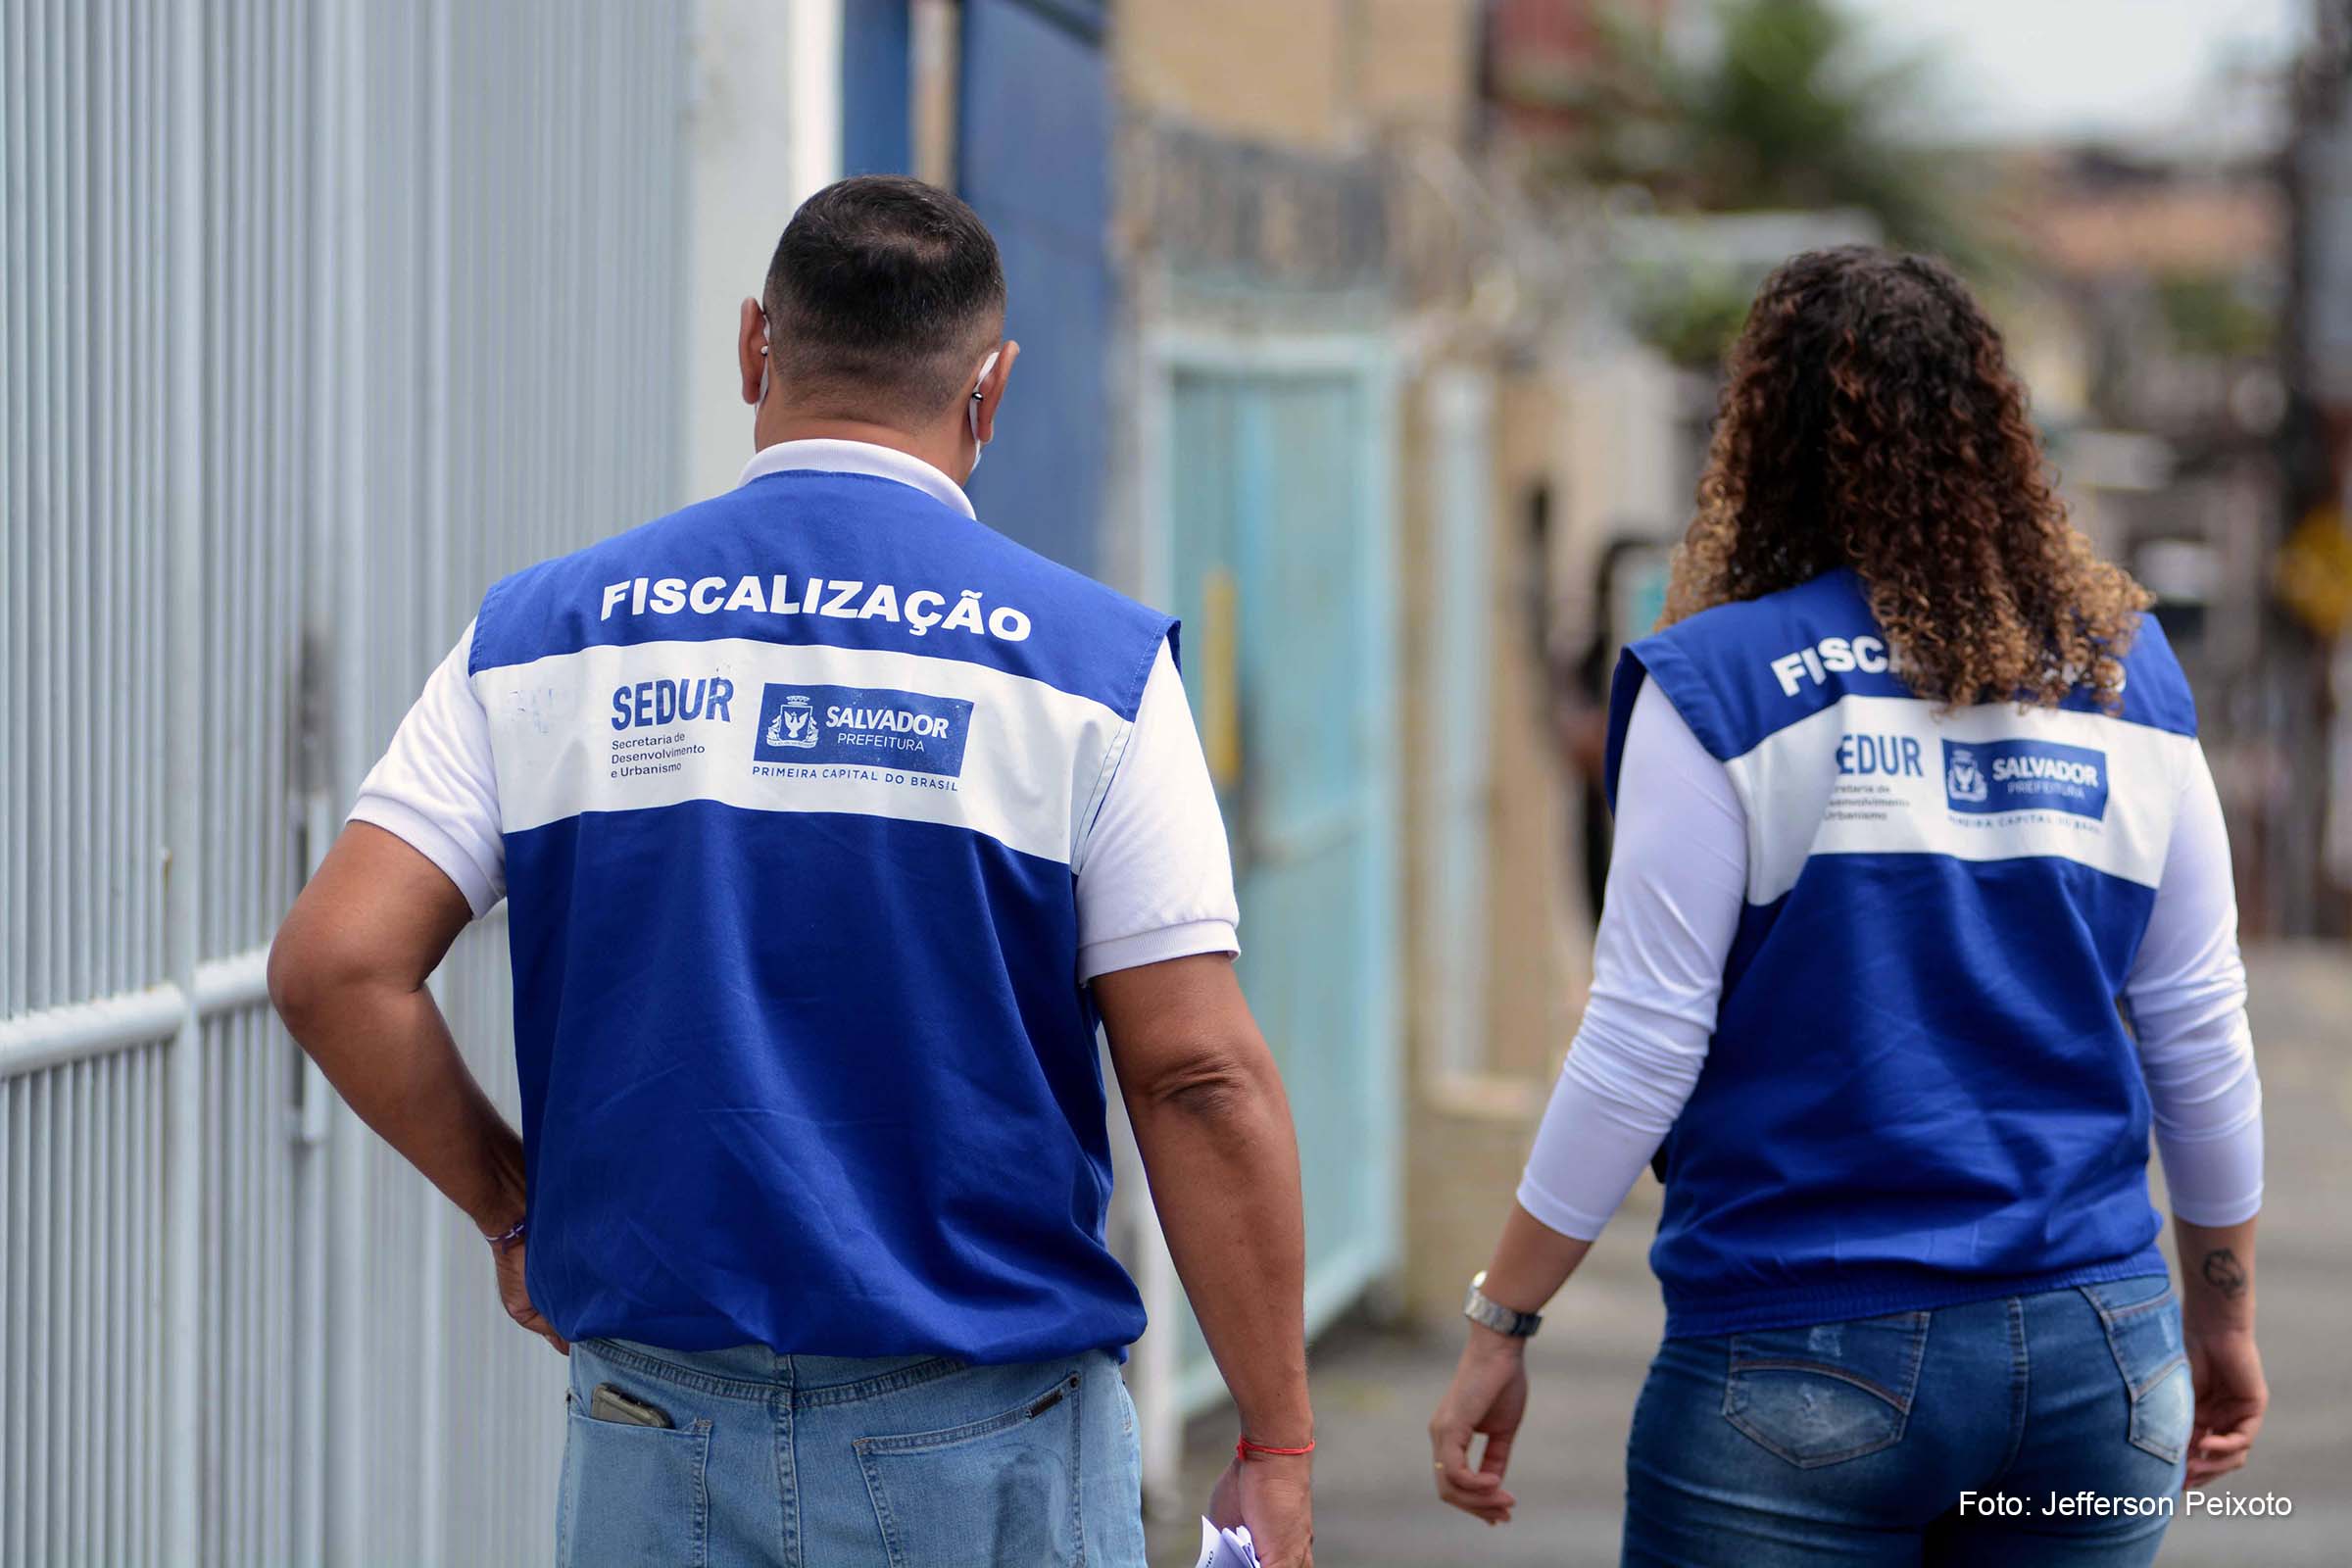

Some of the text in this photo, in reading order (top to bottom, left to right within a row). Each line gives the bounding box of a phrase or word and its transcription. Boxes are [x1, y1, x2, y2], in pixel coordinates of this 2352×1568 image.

[600, 574, 1032, 642] FISCALIZAÇÃO
[612, 676, 734, 731] SEDUR
[825, 706, 950, 739] SALVADOR
[612, 732, 685, 751] Secretaria de
[612, 745, 706, 764] Desenvolvimento
[837, 733, 925, 752] PREFEITURA
[1837, 734, 1924, 777] EDUR
[620, 762, 682, 777] Urbanismo
[753, 766, 958, 792] PRIMEIRA CAPITAL DO BRASIL
[1992, 757, 2098, 788] SALVADOR
